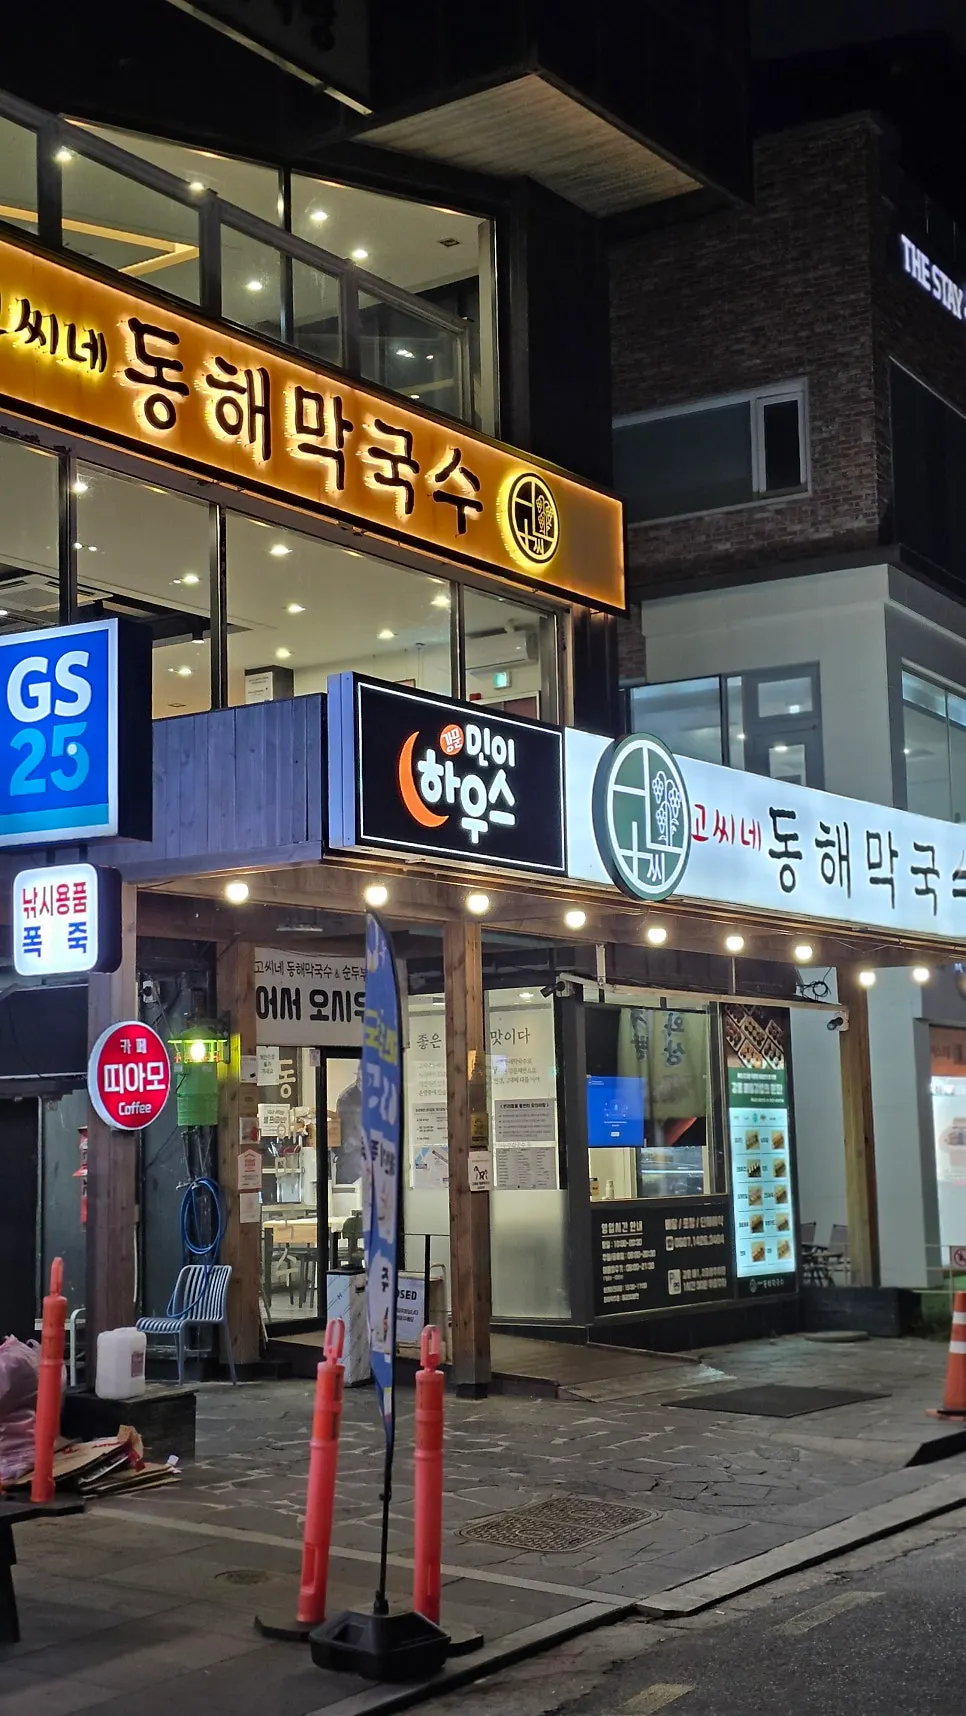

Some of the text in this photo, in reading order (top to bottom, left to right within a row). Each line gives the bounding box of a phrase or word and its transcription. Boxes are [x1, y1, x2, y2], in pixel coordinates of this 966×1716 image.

[900, 233, 964, 320] THE STAY
[0, 298, 485, 536] 씨네 동해막국수
[6, 649, 92, 724] GS
[9, 721, 90, 797] 25
[465, 723, 516, 767] 민이
[417, 748, 516, 844] 하우스
[690, 803, 763, 852] 고씨네
[22, 881, 88, 919] 낚시용품
[254, 960, 284, 976] 고씨네
[286, 961, 333, 978] 동해막국수
[255, 985, 302, 1021] 어서
[416, 1032, 442, 1050] 좋은
[490, 1027, 531, 1046] 맛이다
[104, 1061, 166, 1094] 띠아모
[118, 1100, 152, 1116] Coffee
